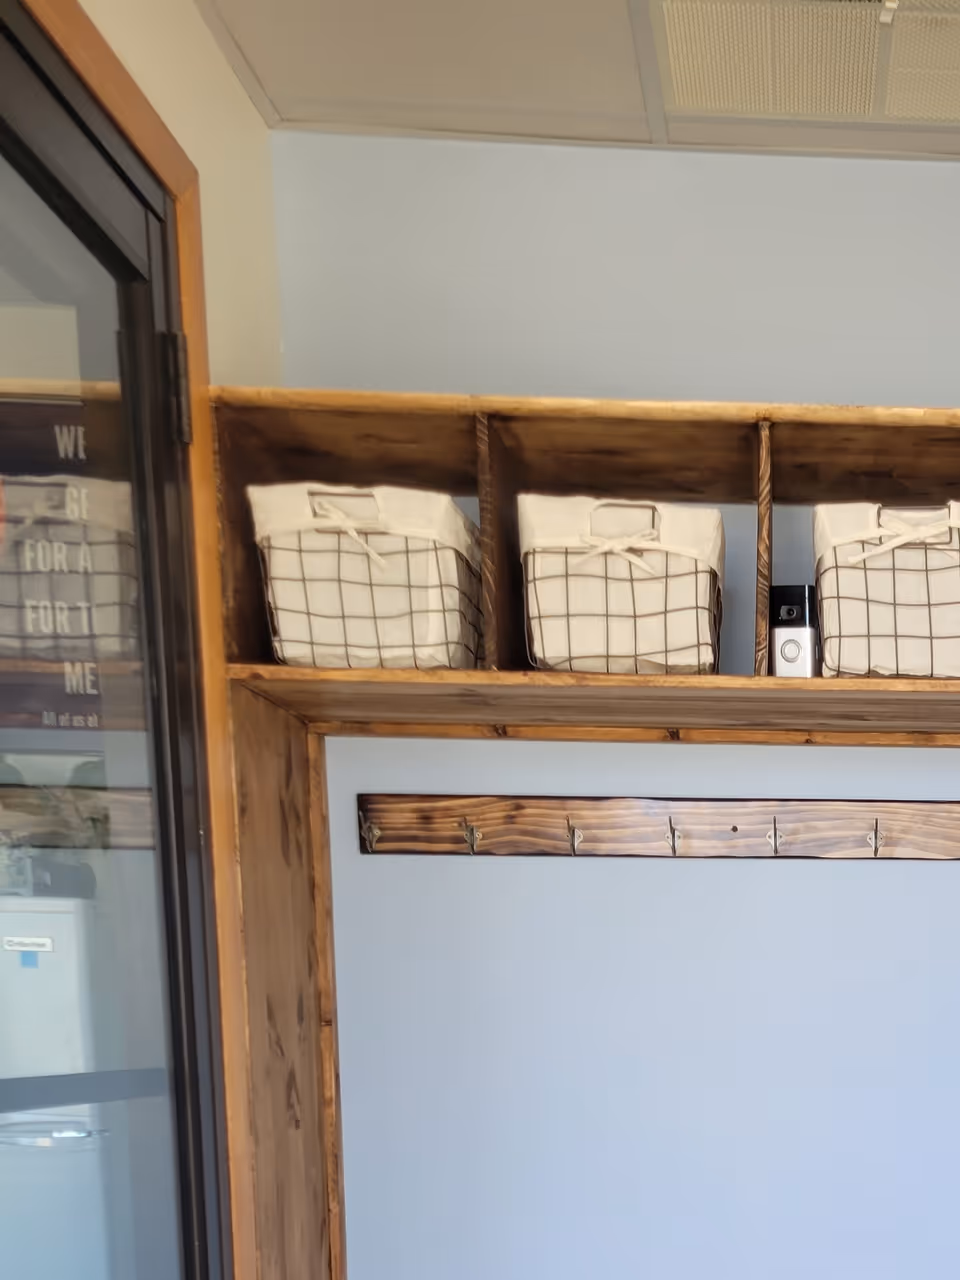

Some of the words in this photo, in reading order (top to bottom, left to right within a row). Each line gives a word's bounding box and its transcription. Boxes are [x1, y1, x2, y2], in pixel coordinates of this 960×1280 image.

[24, 538, 67, 573] FOR
[24, 599, 69, 634] FOR
[64, 661, 98, 695] ME
